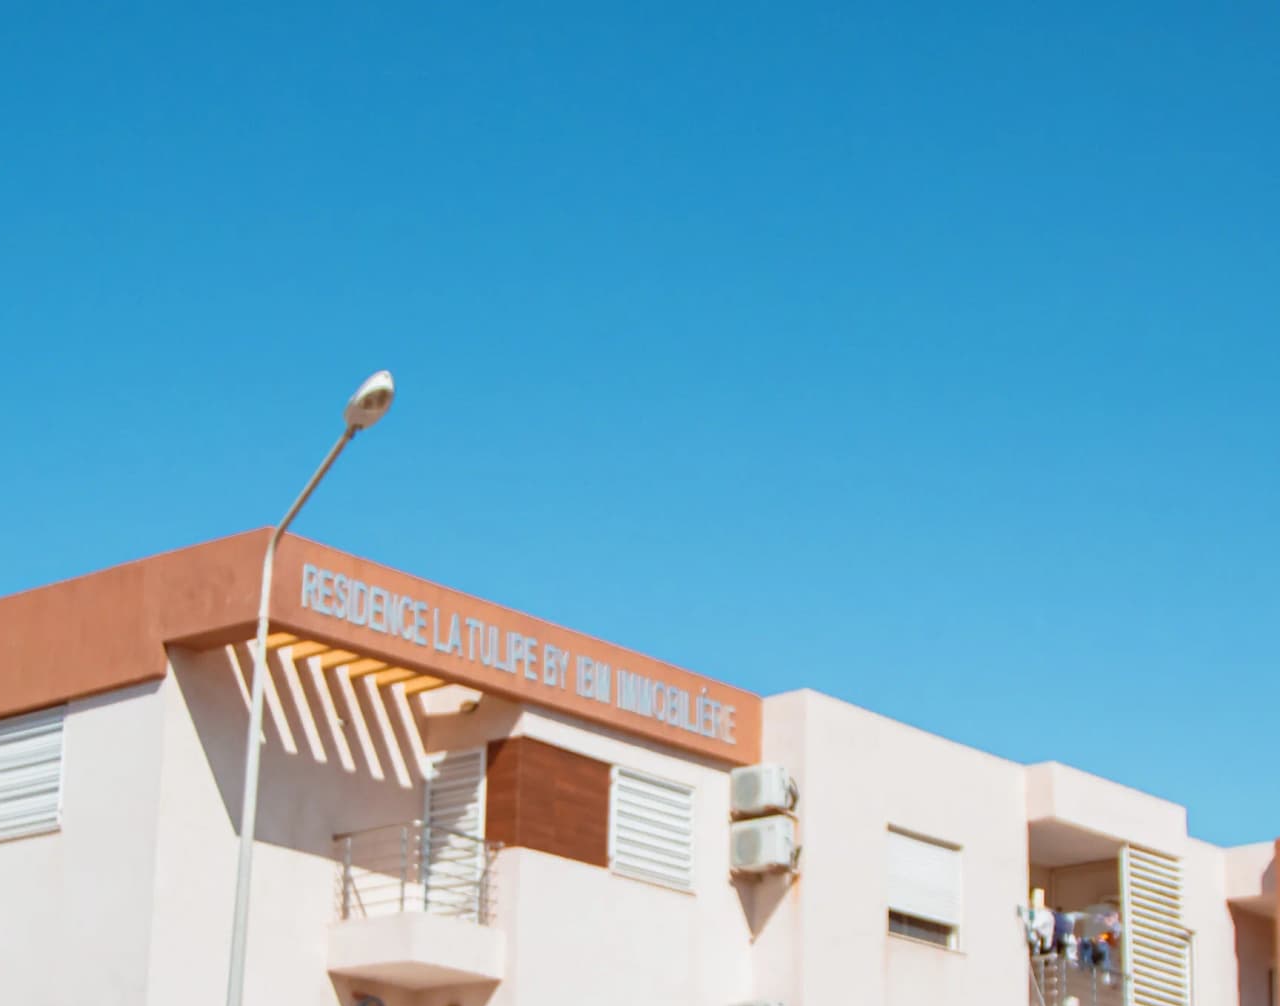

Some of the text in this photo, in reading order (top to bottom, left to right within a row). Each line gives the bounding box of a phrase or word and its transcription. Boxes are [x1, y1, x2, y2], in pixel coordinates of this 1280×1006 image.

[301, 563, 428, 647] RESIDENCE
[433, 607, 463, 656] LA
[465, 617, 538, 681] TULIPE
[542, 643, 571, 690] BY
